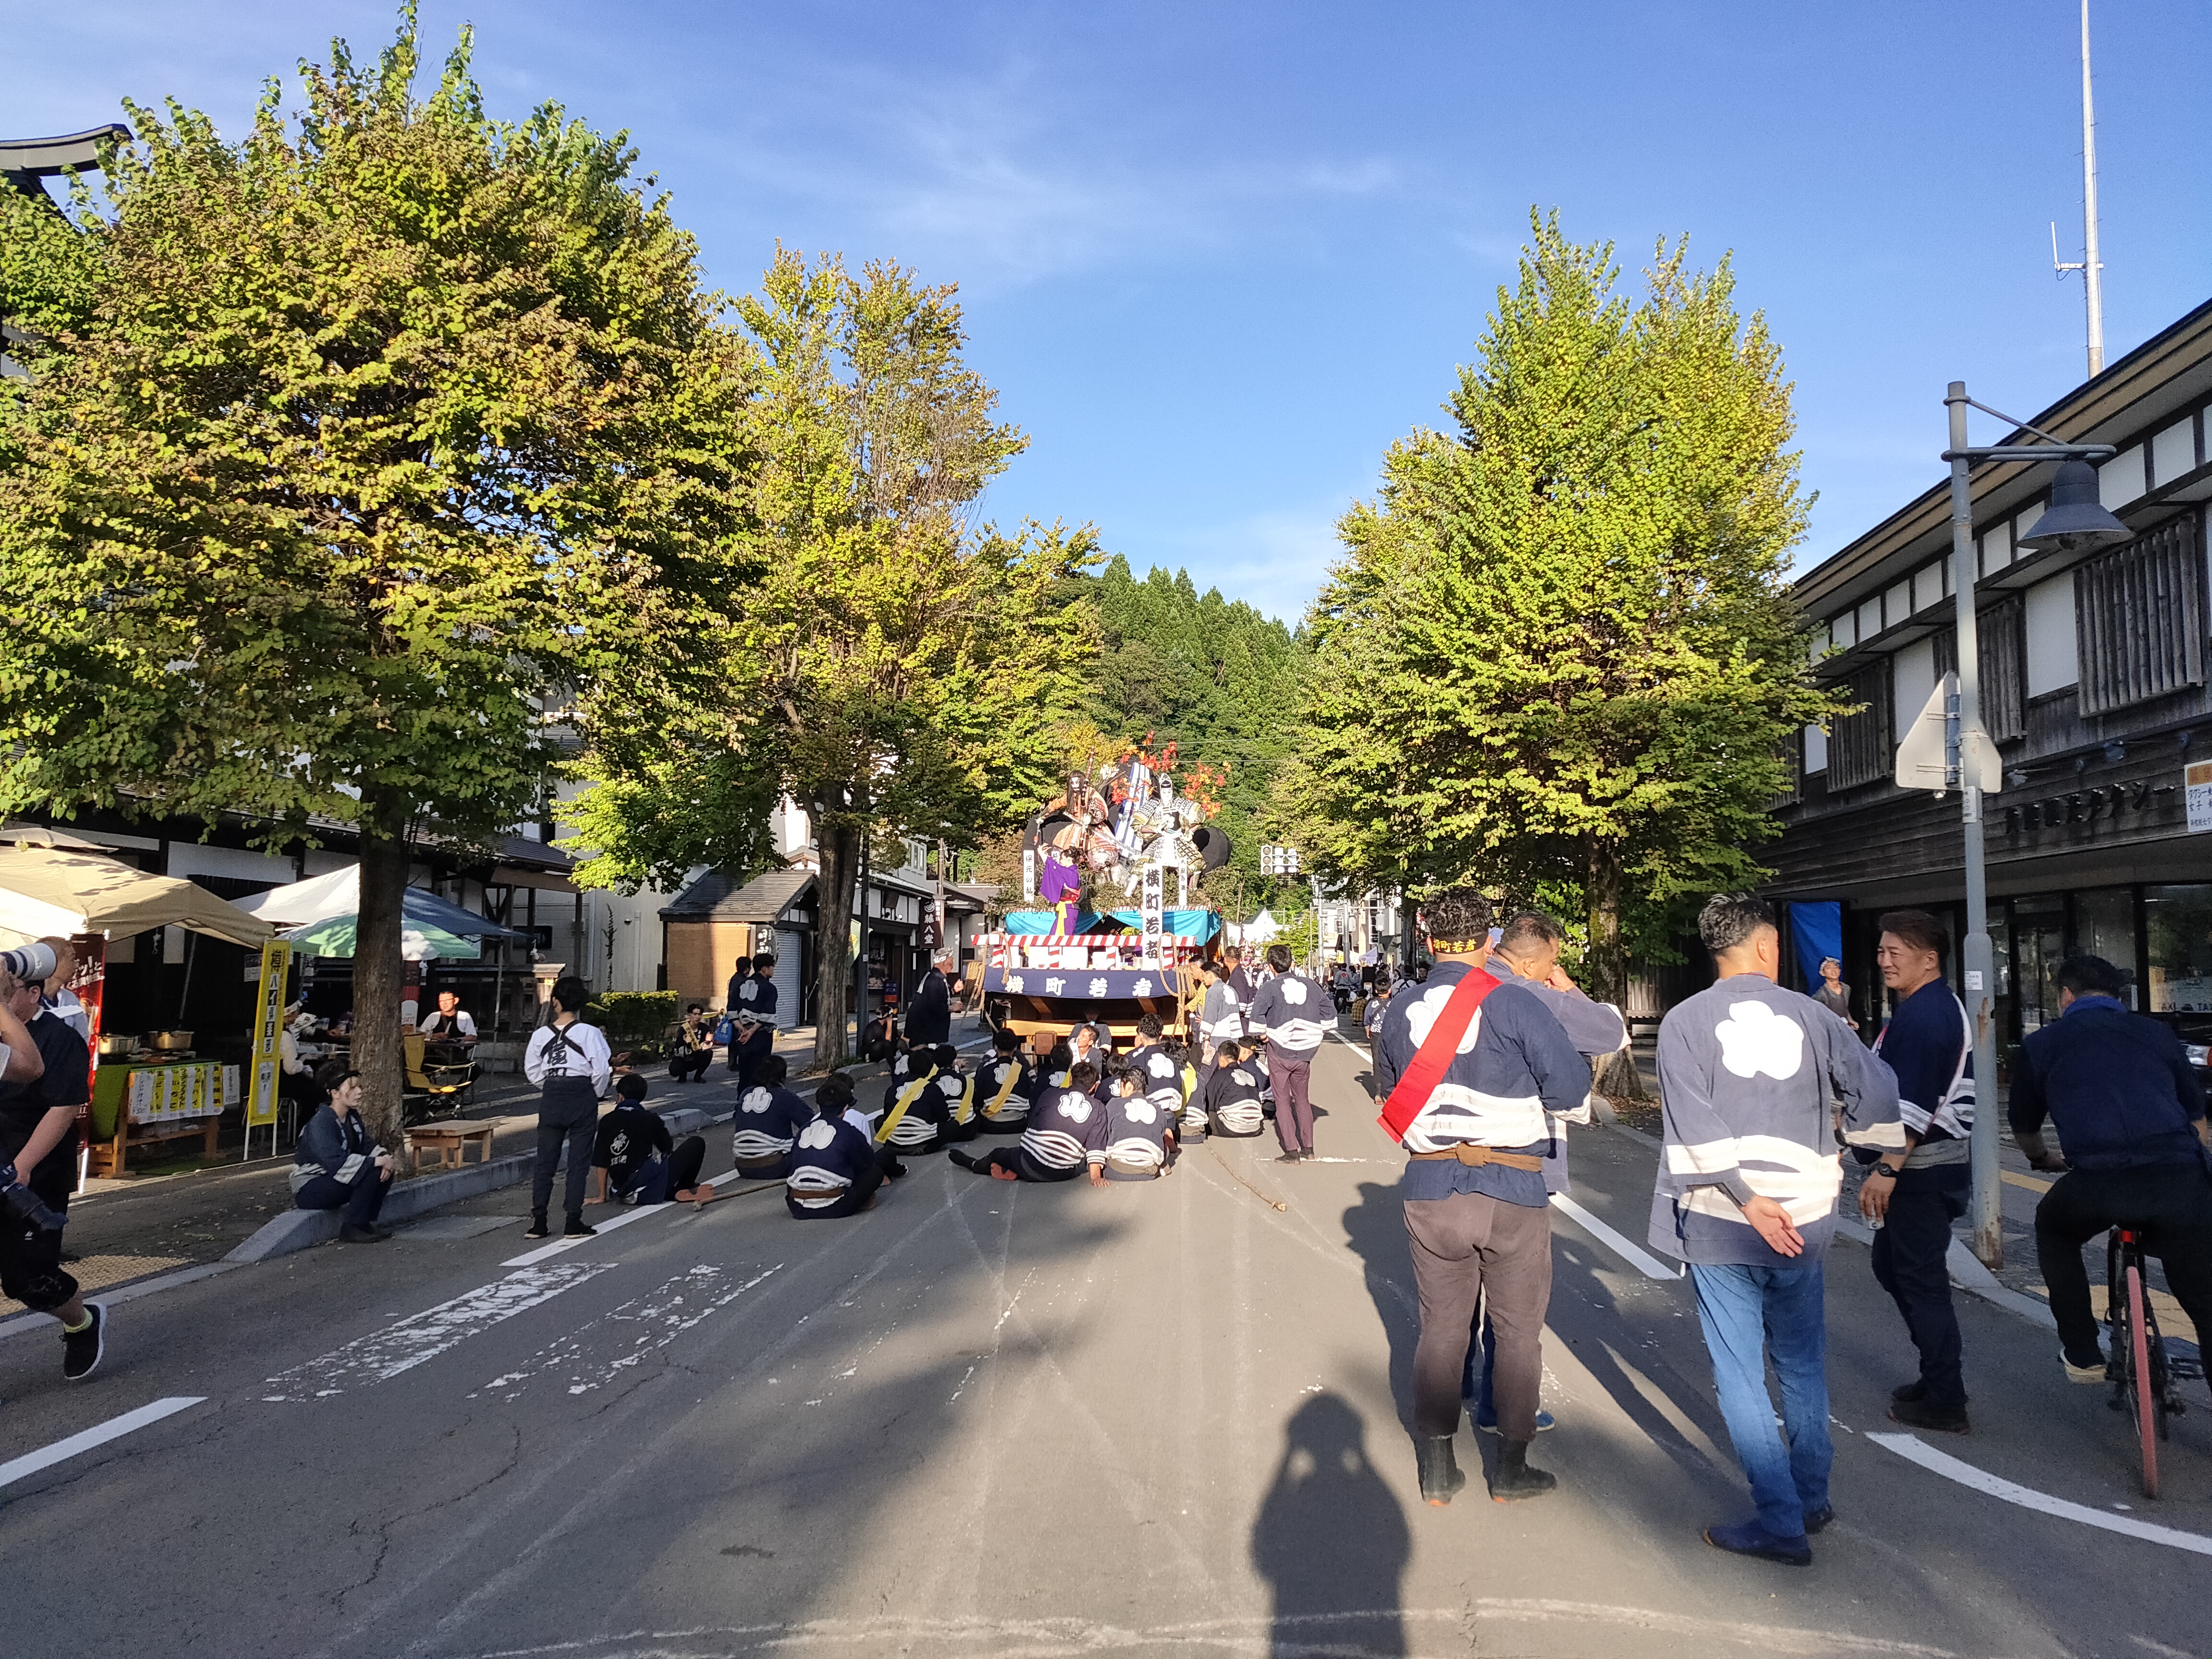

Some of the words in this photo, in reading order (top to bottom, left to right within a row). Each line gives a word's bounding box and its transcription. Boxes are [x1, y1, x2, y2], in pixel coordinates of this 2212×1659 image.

[1145, 869, 1160, 959] 横町若者
[1005, 975, 1152, 998] 横町若者
